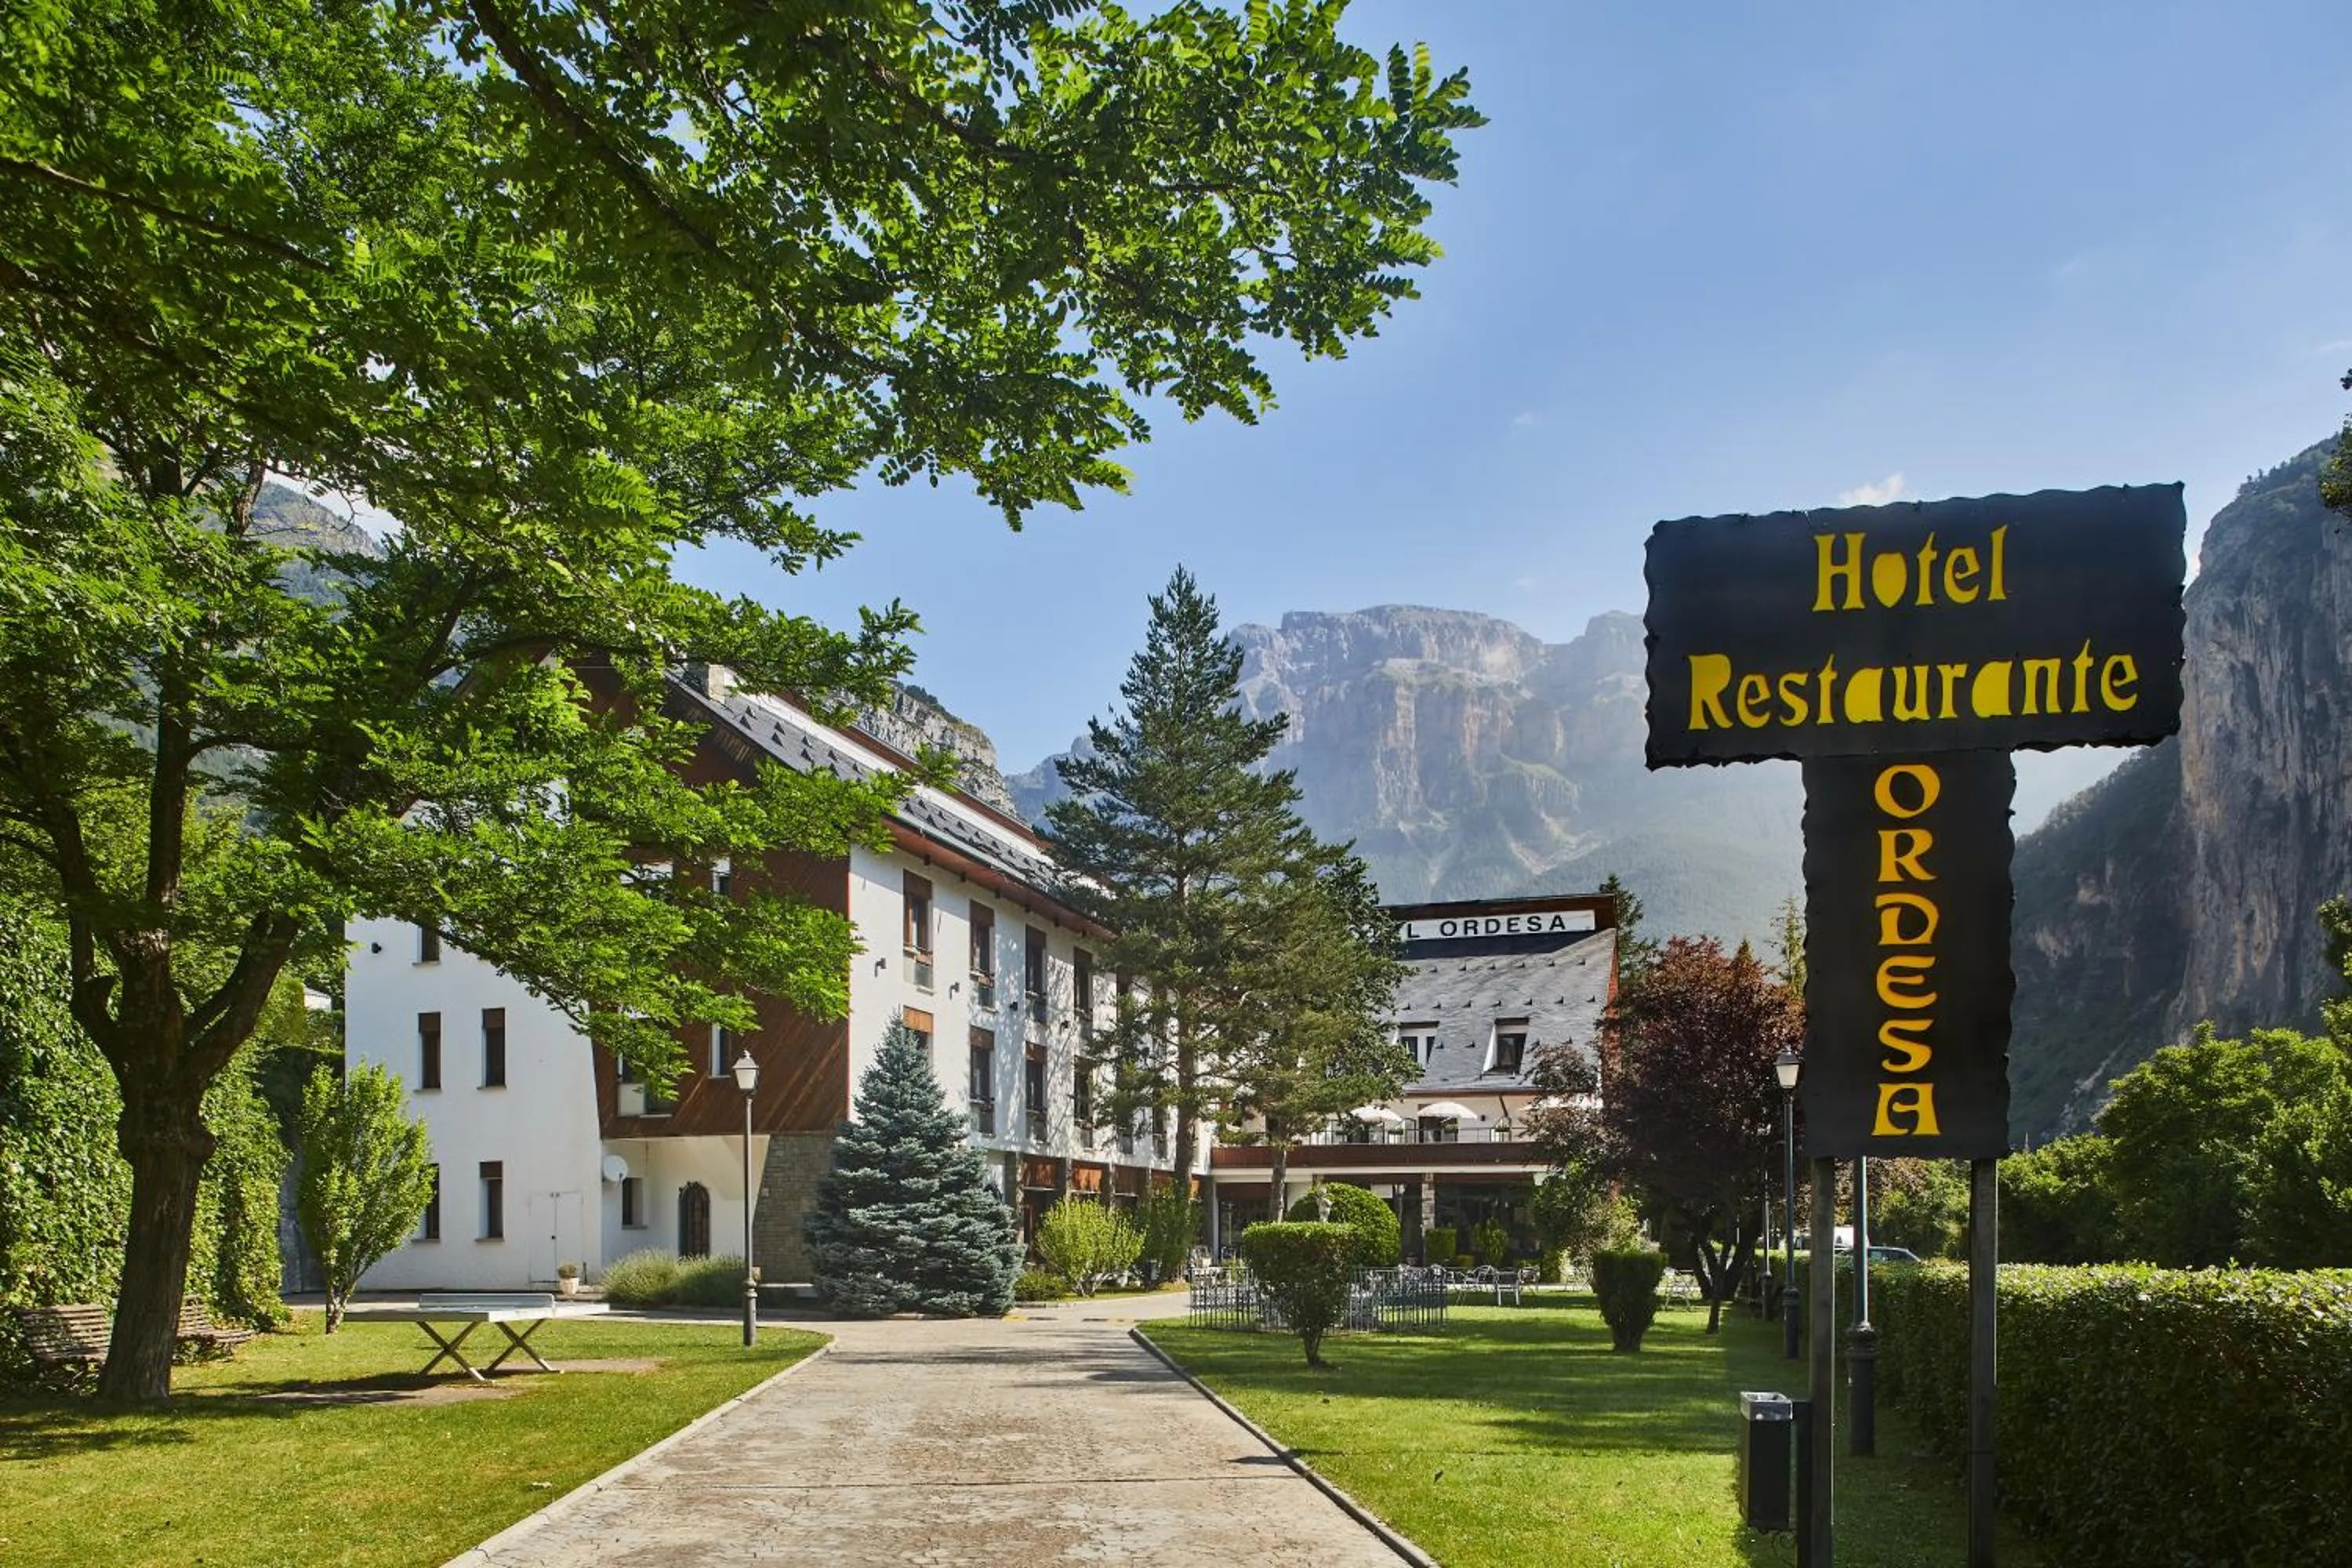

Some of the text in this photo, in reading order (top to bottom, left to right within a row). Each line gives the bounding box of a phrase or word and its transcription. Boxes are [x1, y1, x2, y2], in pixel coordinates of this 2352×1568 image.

[1811, 524, 2008, 612] Hotel
[1687, 638, 2139, 731] Restaurante
[1439, 913, 1566, 938] ORDESA
[1871, 764, 1941, 1137] ORDESA
